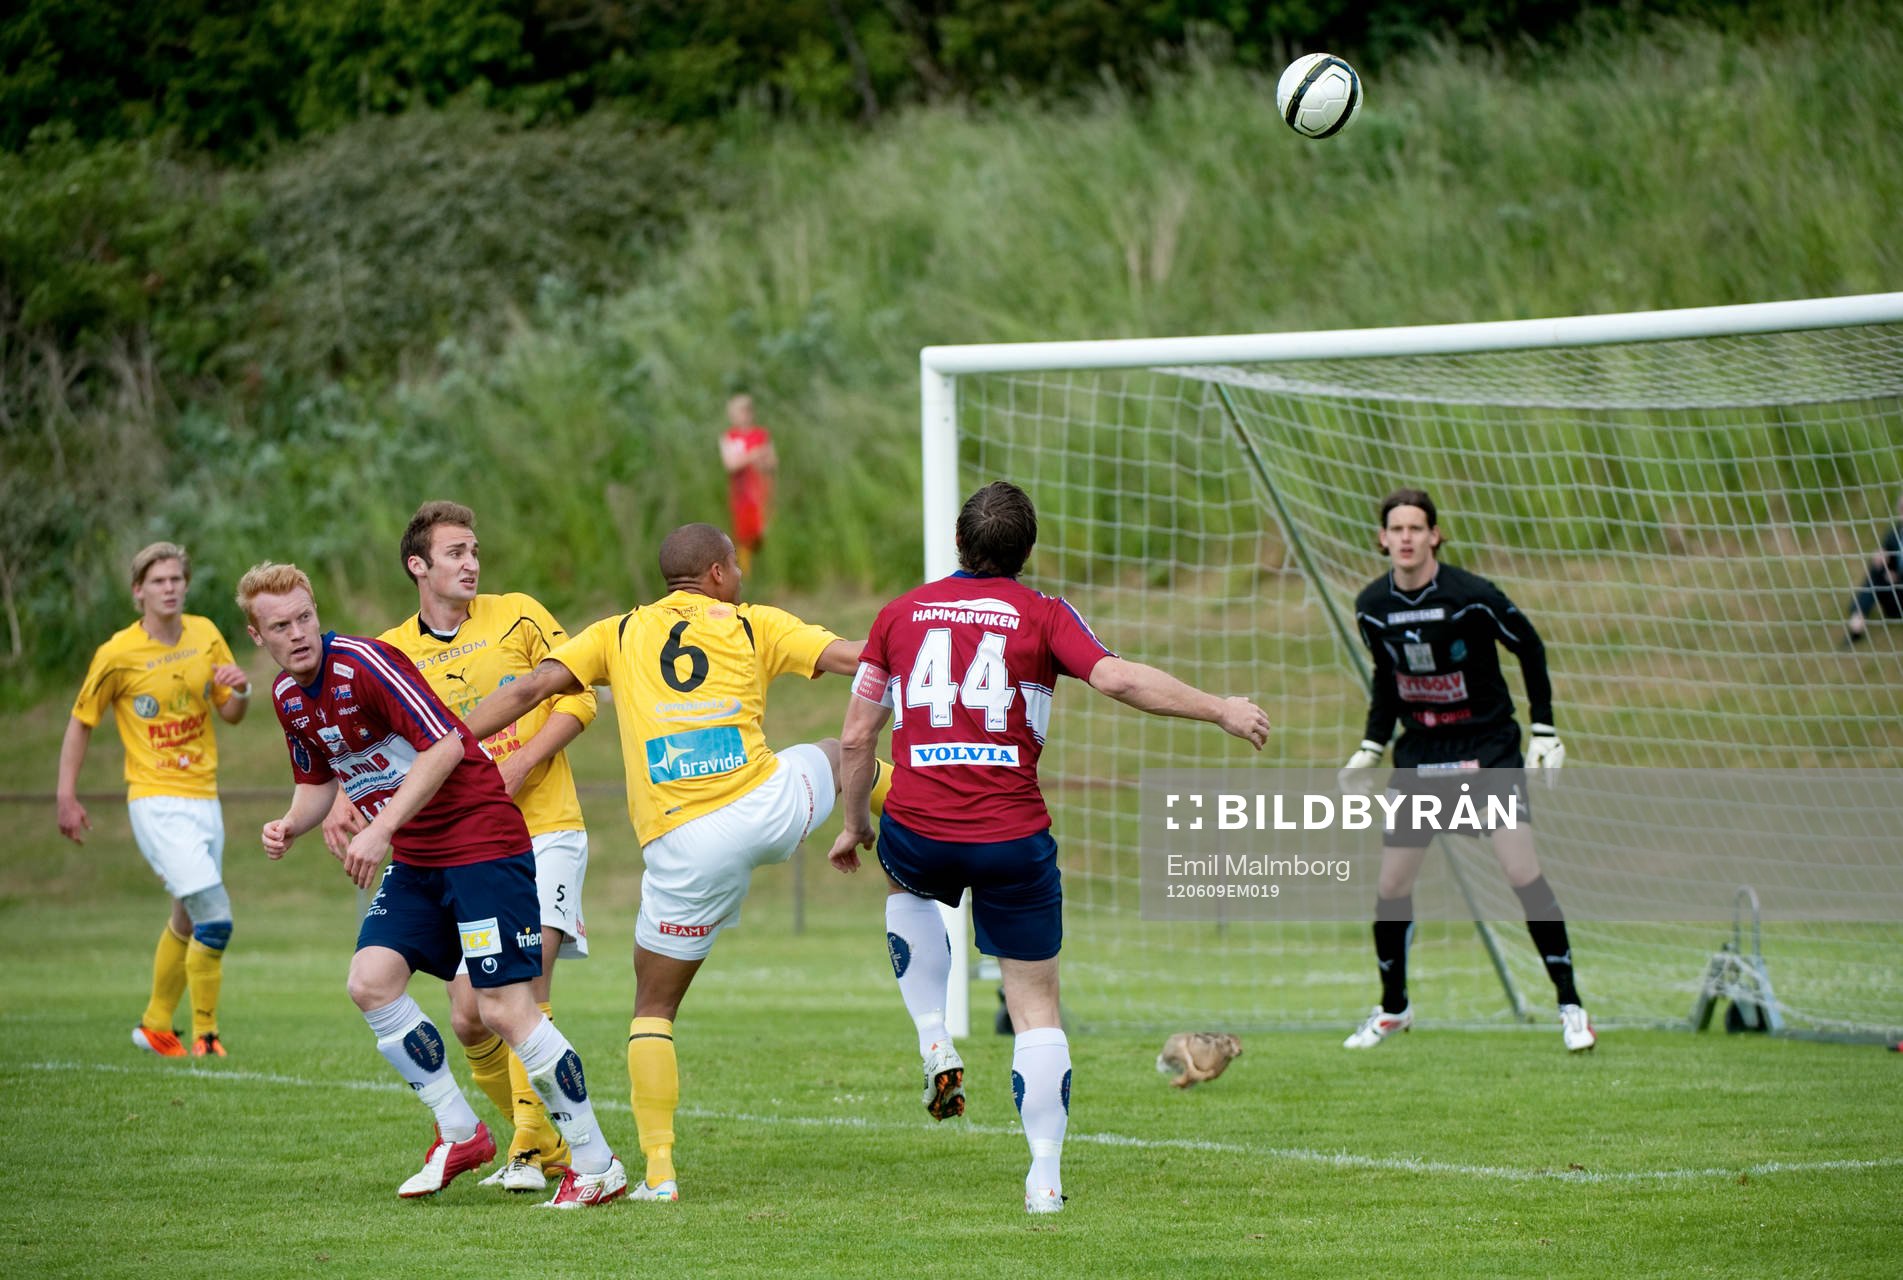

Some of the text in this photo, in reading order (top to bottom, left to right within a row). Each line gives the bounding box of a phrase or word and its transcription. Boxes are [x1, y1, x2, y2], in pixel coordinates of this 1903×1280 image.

[912, 608, 1020, 630] HAMMARVIKEN
[417, 640, 487, 670] BYGGOM
[660, 621, 709, 693] 6
[906, 627, 1016, 732] 44
[679, 753, 744, 777] bravida
[915, 747, 1016, 763] VOLVIA
[556, 884, 566, 902] 5
[516, 931, 541, 948] frien
[661, 922, 700, 936] TEAM
